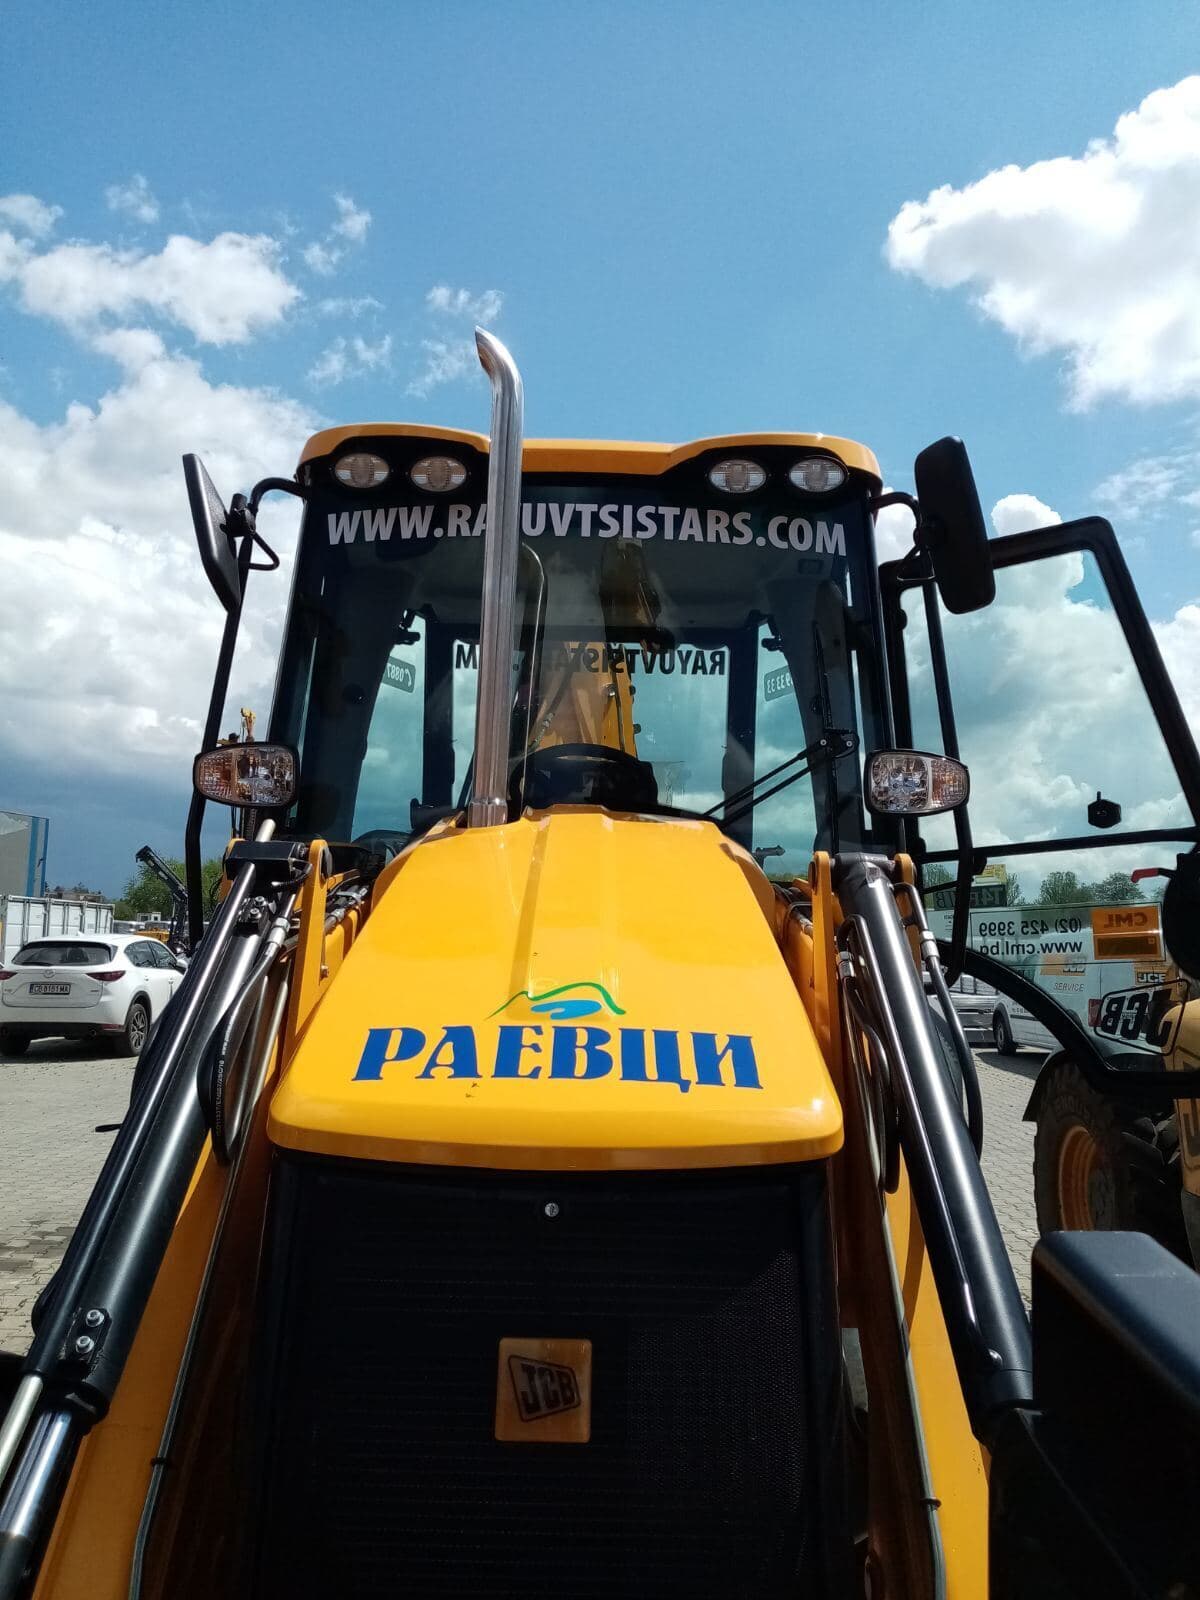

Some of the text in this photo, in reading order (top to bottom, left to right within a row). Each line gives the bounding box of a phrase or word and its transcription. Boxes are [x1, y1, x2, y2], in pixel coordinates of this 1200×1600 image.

[327, 502, 847, 556] WWW.RAUVTSISTARS.COM
[351, 1025, 764, 1093] РАЕВЦИ
[519, 1362, 577, 1415] JCB
